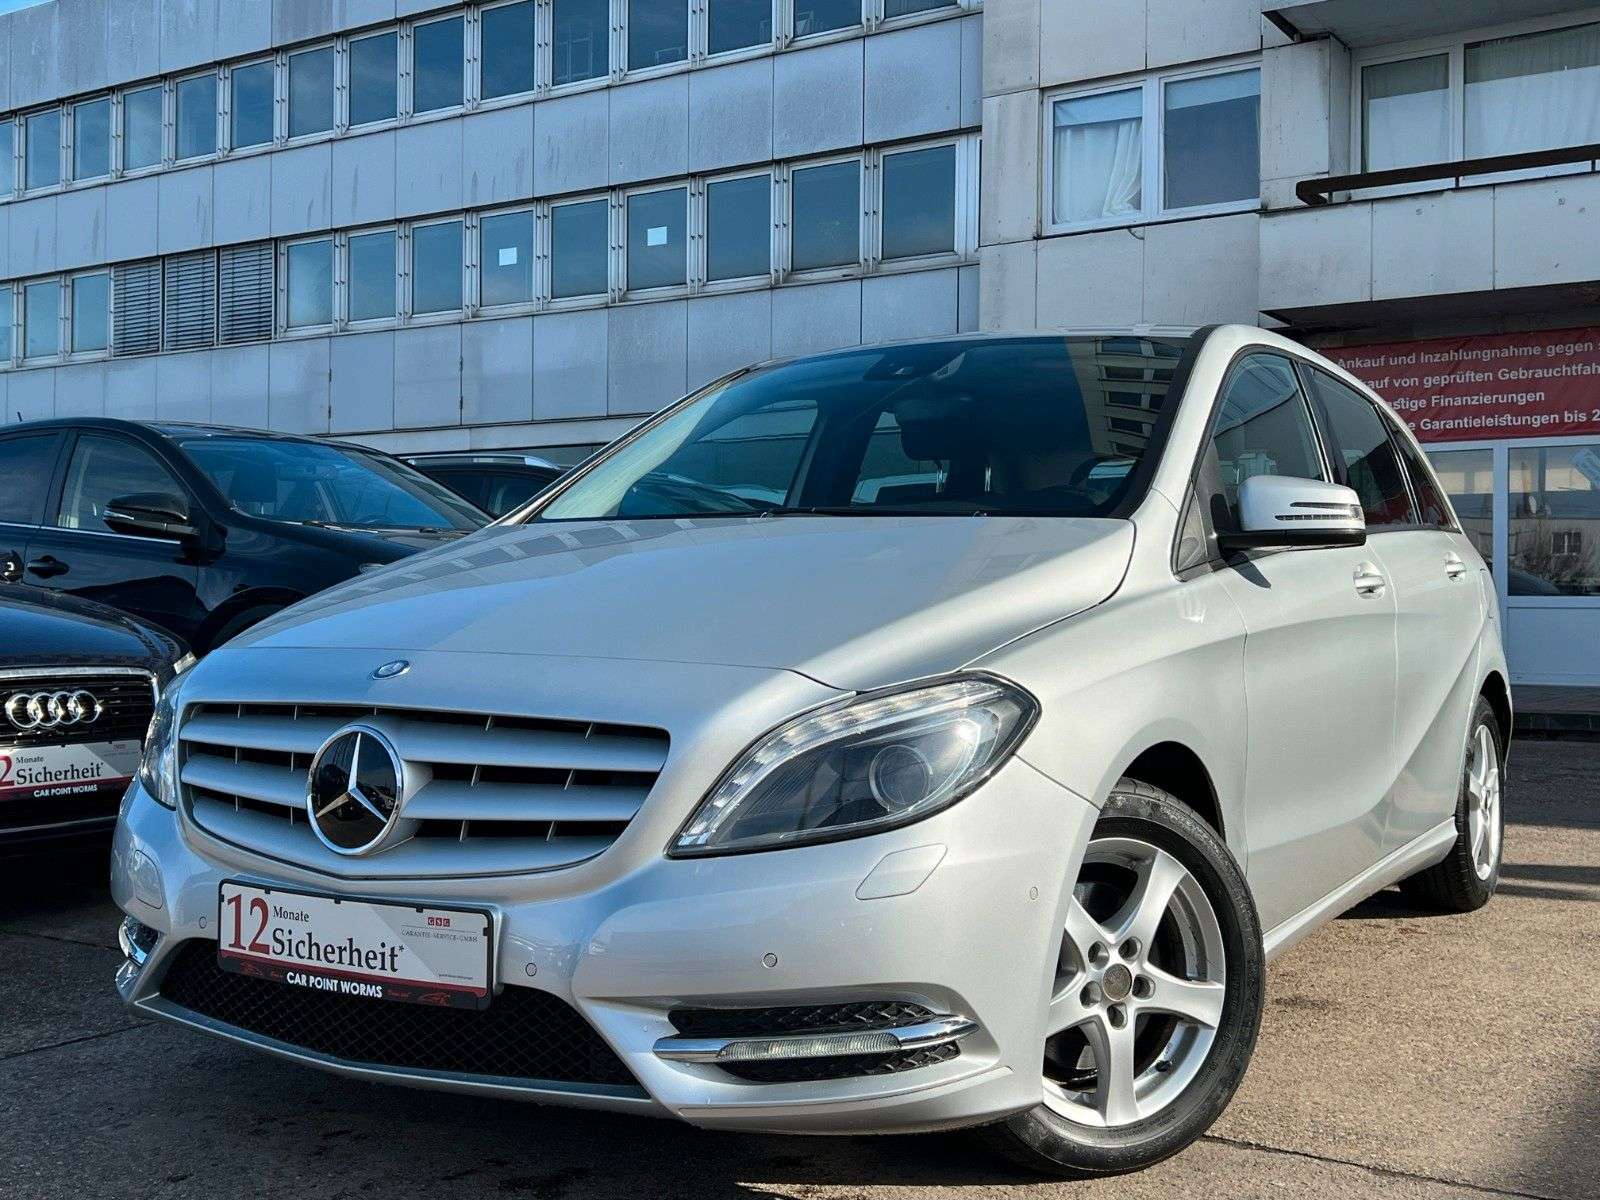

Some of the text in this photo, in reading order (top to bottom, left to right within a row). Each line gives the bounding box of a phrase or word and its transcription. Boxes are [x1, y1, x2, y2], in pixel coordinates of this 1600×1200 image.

[1337, 355, 1386, 370] Ankauf
[1390, 353, 1416, 366] und
[1420, 344, 1541, 364] Inzahlungnahme
[1546, 341, 1593, 357] gegen
[1393, 377, 1419, 388] von
[1423, 370, 1493, 389] geprüften
[1498, 362, 1600, 380] Gebrauchtfah
[1431, 391, 1545, 408] Finanzierungen
[1420, 413, 1559, 430] Garantieleistungen
[1564, 410, 1587, 423] bis
[16, 756, 44, 764] Monate
[33, 784, 98, 798] CAR POINT WORMS
[273, 905, 310, 923] Monate
[227, 894, 270, 955] 12
[286, 971, 307, 987] CAR
[309, 976, 339, 993] POINT
[340, 981, 383, 999] WORMS
